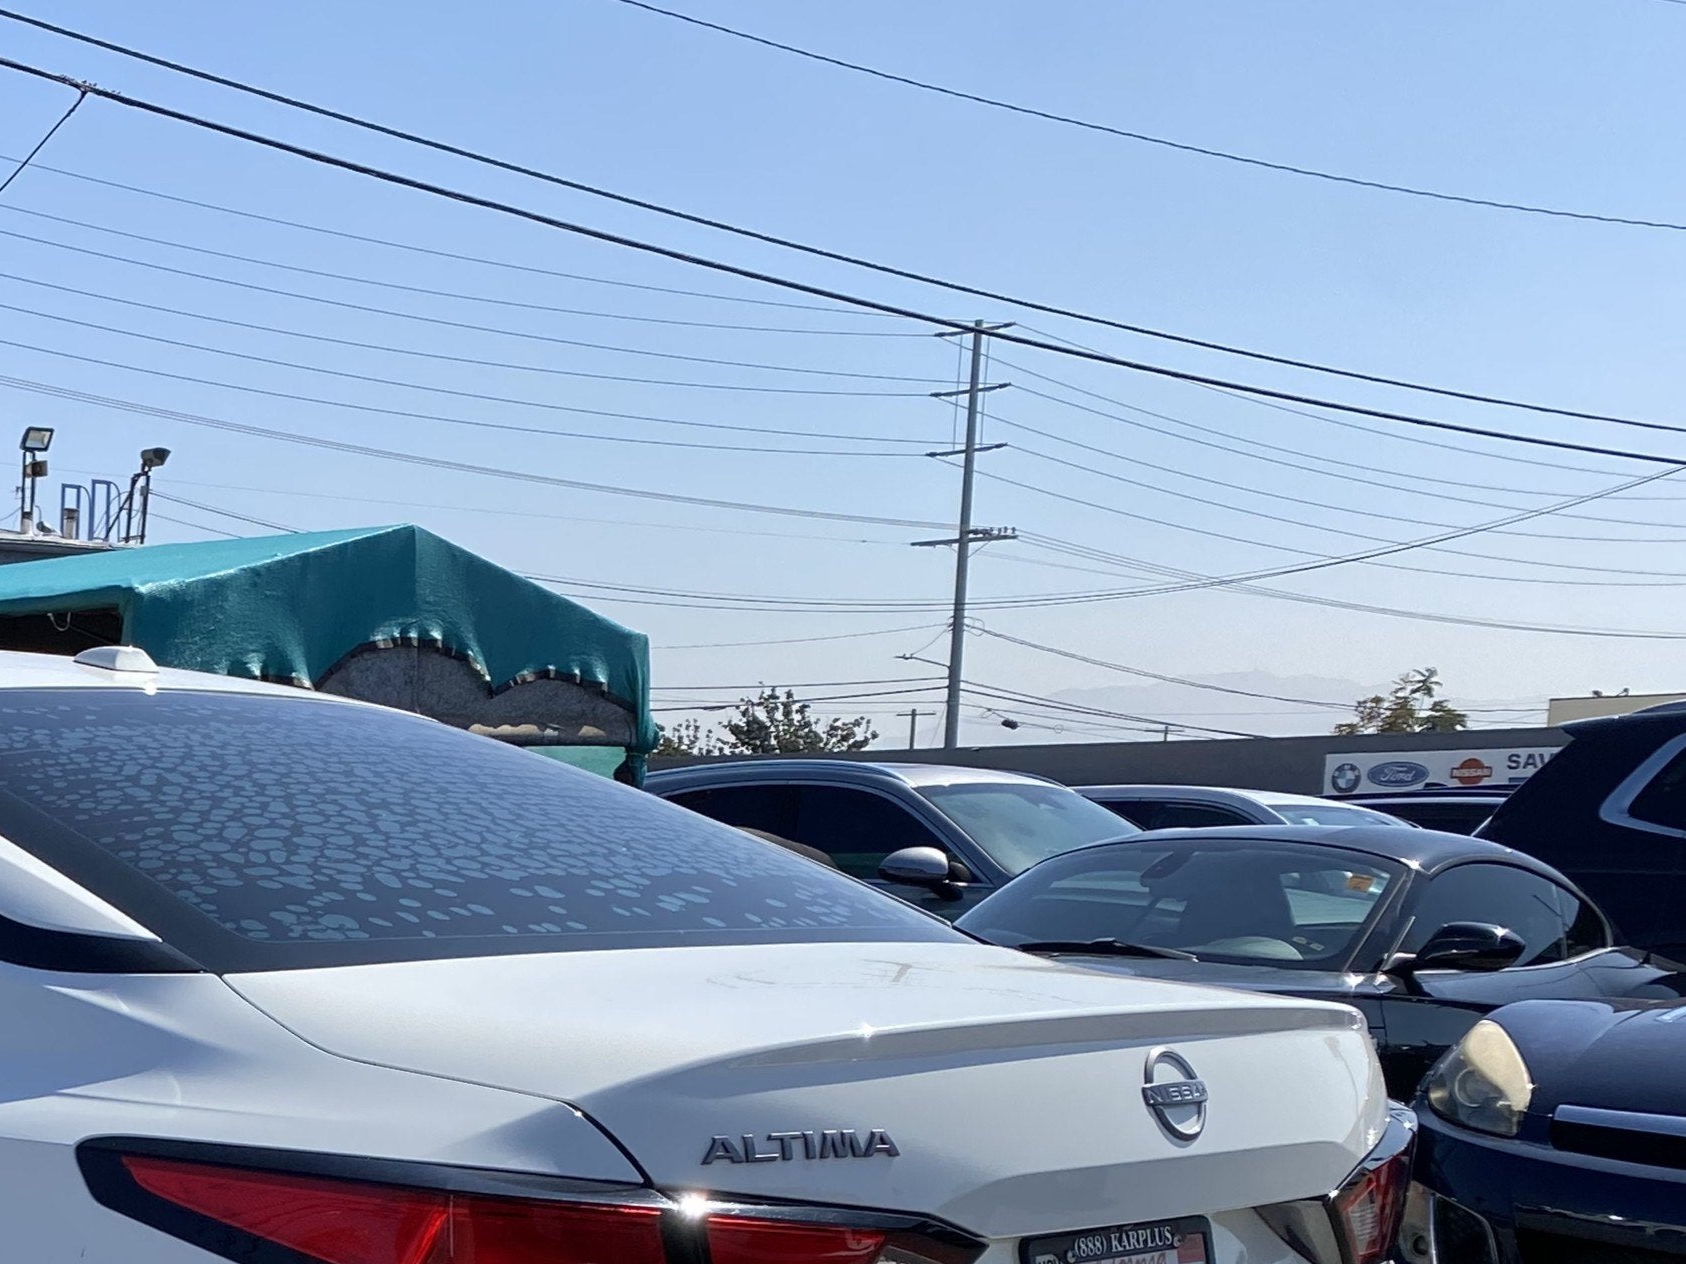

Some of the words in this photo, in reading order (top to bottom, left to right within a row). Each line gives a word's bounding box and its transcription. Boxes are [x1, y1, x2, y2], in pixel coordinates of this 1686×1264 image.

[1380, 766, 1415, 782] Ford
[1452, 768, 1492, 778] NISSAN
[700, 1128, 901, 1166] ALTIMA
[1074, 1236, 1107, 1258] (888)
[1111, 1226, 1173, 1252] KARPLUS
